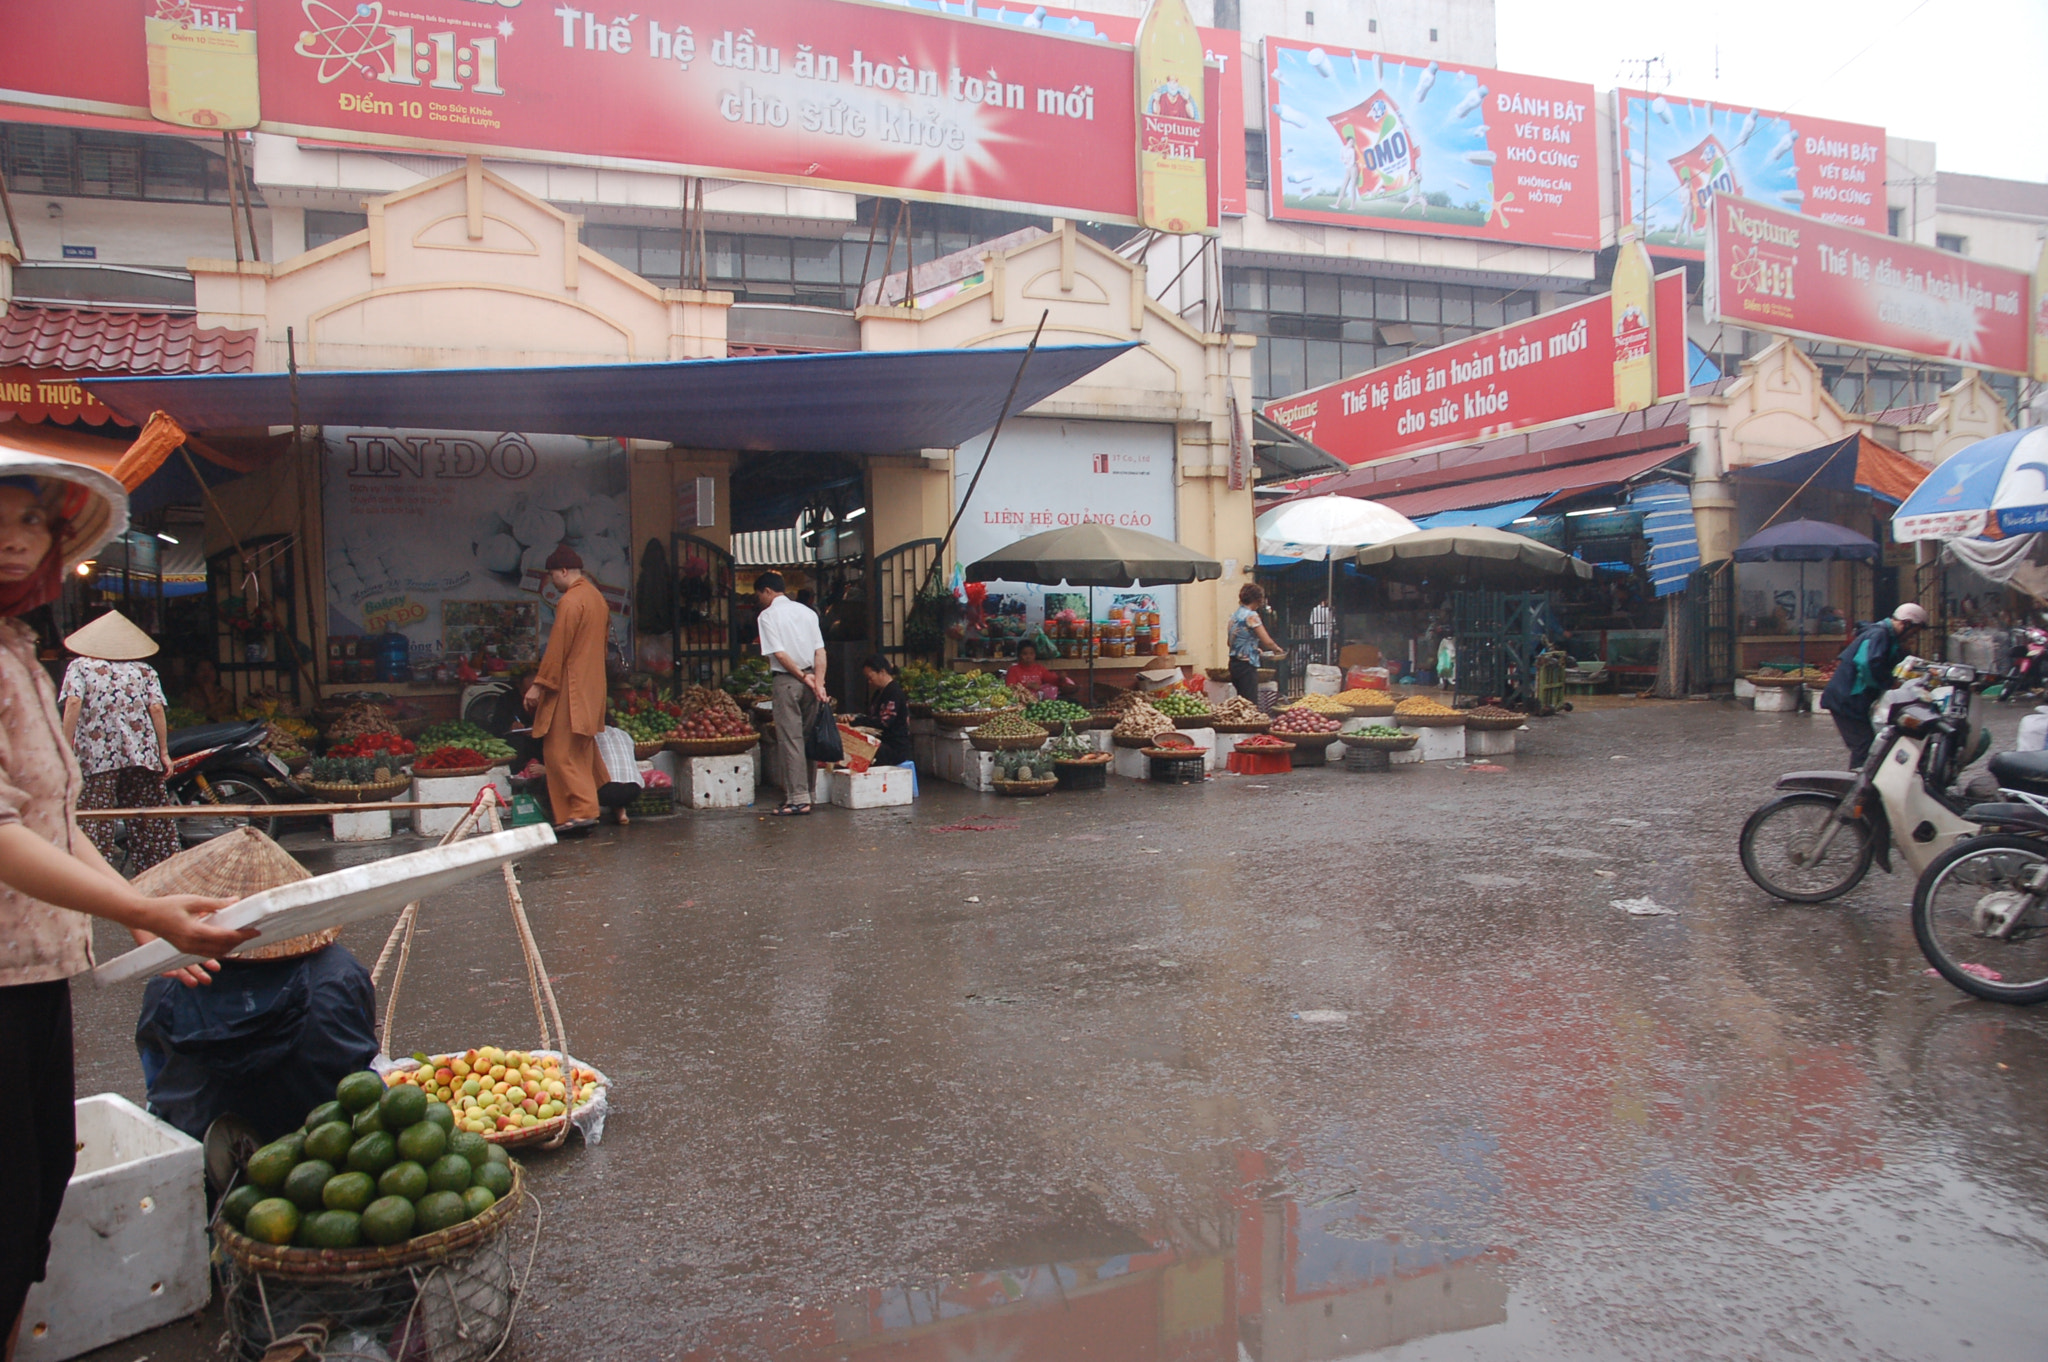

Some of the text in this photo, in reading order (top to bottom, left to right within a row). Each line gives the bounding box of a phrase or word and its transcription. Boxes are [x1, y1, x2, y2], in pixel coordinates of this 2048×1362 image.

[385, 26, 505, 96] 1:1:1
[555, 7, 1094, 121] Thế hệ dầu ăn hoàn toàn mới
[339, 92, 423, 119] Điểm 10
[429, 102, 493, 116] Cho Sức Khỏe
[720, 86, 965, 151] cho sức khỏe
[1496, 93, 1585, 126] ĐÁNH BẬT
[429, 112, 501, 129] Cho Chất Lượng
[1145, 117, 1201, 138] Neptune
[1515, 121, 1540, 140] VẾT
[1363, 131, 1407, 171] OMO
[1507, 146, 1538, 164] KHÔ
[1805, 136, 1878, 167] ĐÁNH BẬT
[1518, 175, 1551, 189] KHÔNG
[1819, 163, 1841, 179] VẾT
[1545, 193, 1563, 207] TRỢ
[1812, 185, 1837, 201] KHÔ
[1726, 204, 1800, 249] Neptune
[1818, 244, 2019, 316] Thế hệ dầu ăn hoàn toàn mới
[1615, 331, 1647, 348] Neptune
[1341, 318, 1587, 416] Thế hệ dầu ăn hoàn toàn mới
[37, 384, 82, 410] THỰC
[1397, 383, 1509, 436] cho sức khỏe
[1272, 400, 1319, 427] Neptune
[984, 507, 1152, 528] LIÊN HỆ QUẢNG CÁO
